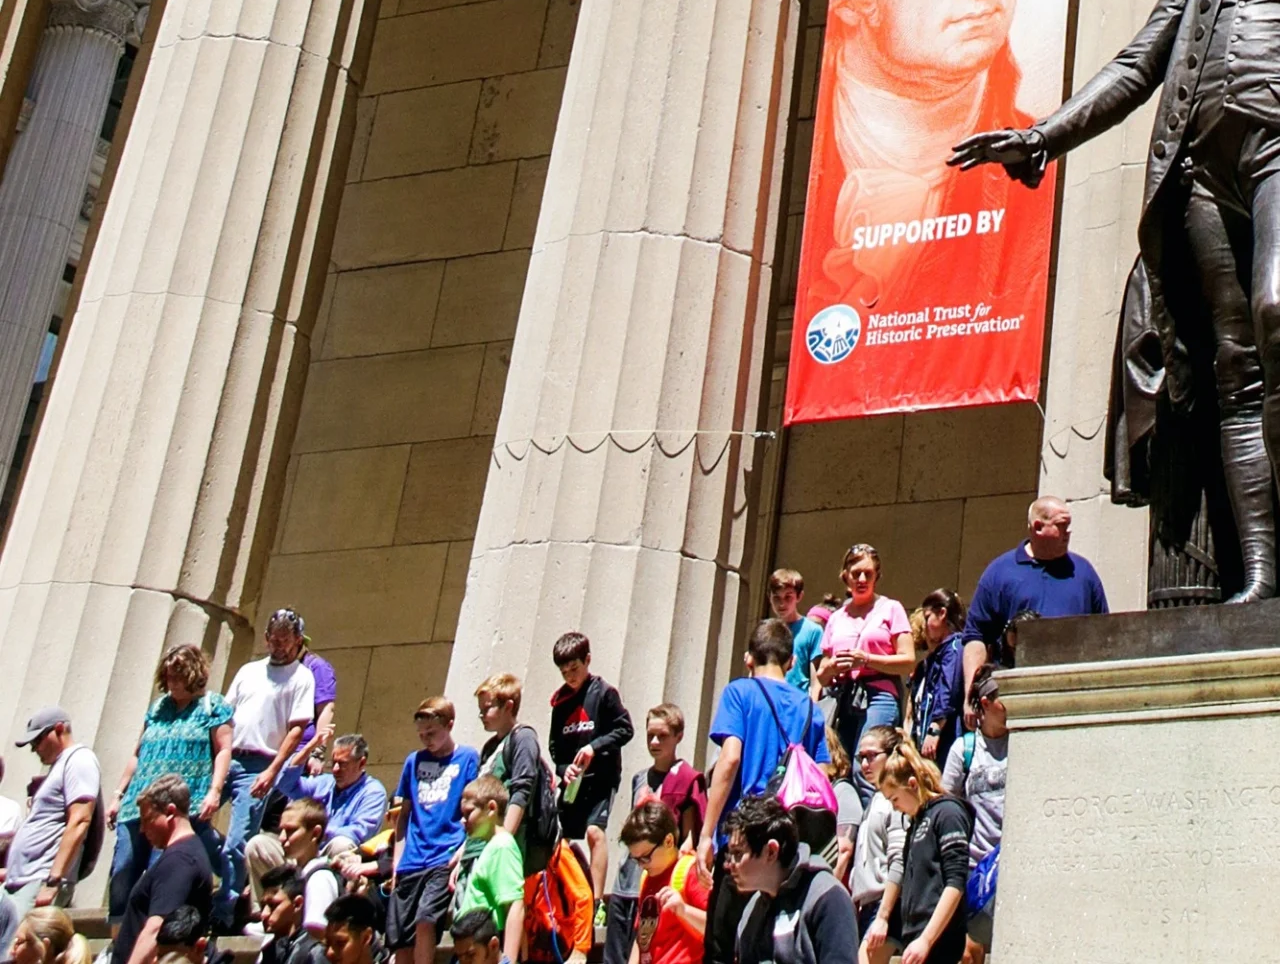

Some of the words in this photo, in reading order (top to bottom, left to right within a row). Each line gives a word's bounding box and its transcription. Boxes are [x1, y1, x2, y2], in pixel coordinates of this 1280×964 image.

[852, 213, 972, 250] SUPPORTED
[976, 208, 1005, 233] BY
[868, 308, 929, 328] National
[933, 303, 970, 319] Trust
[971, 302, 992, 321] for
[866, 325, 923, 346] Historic
